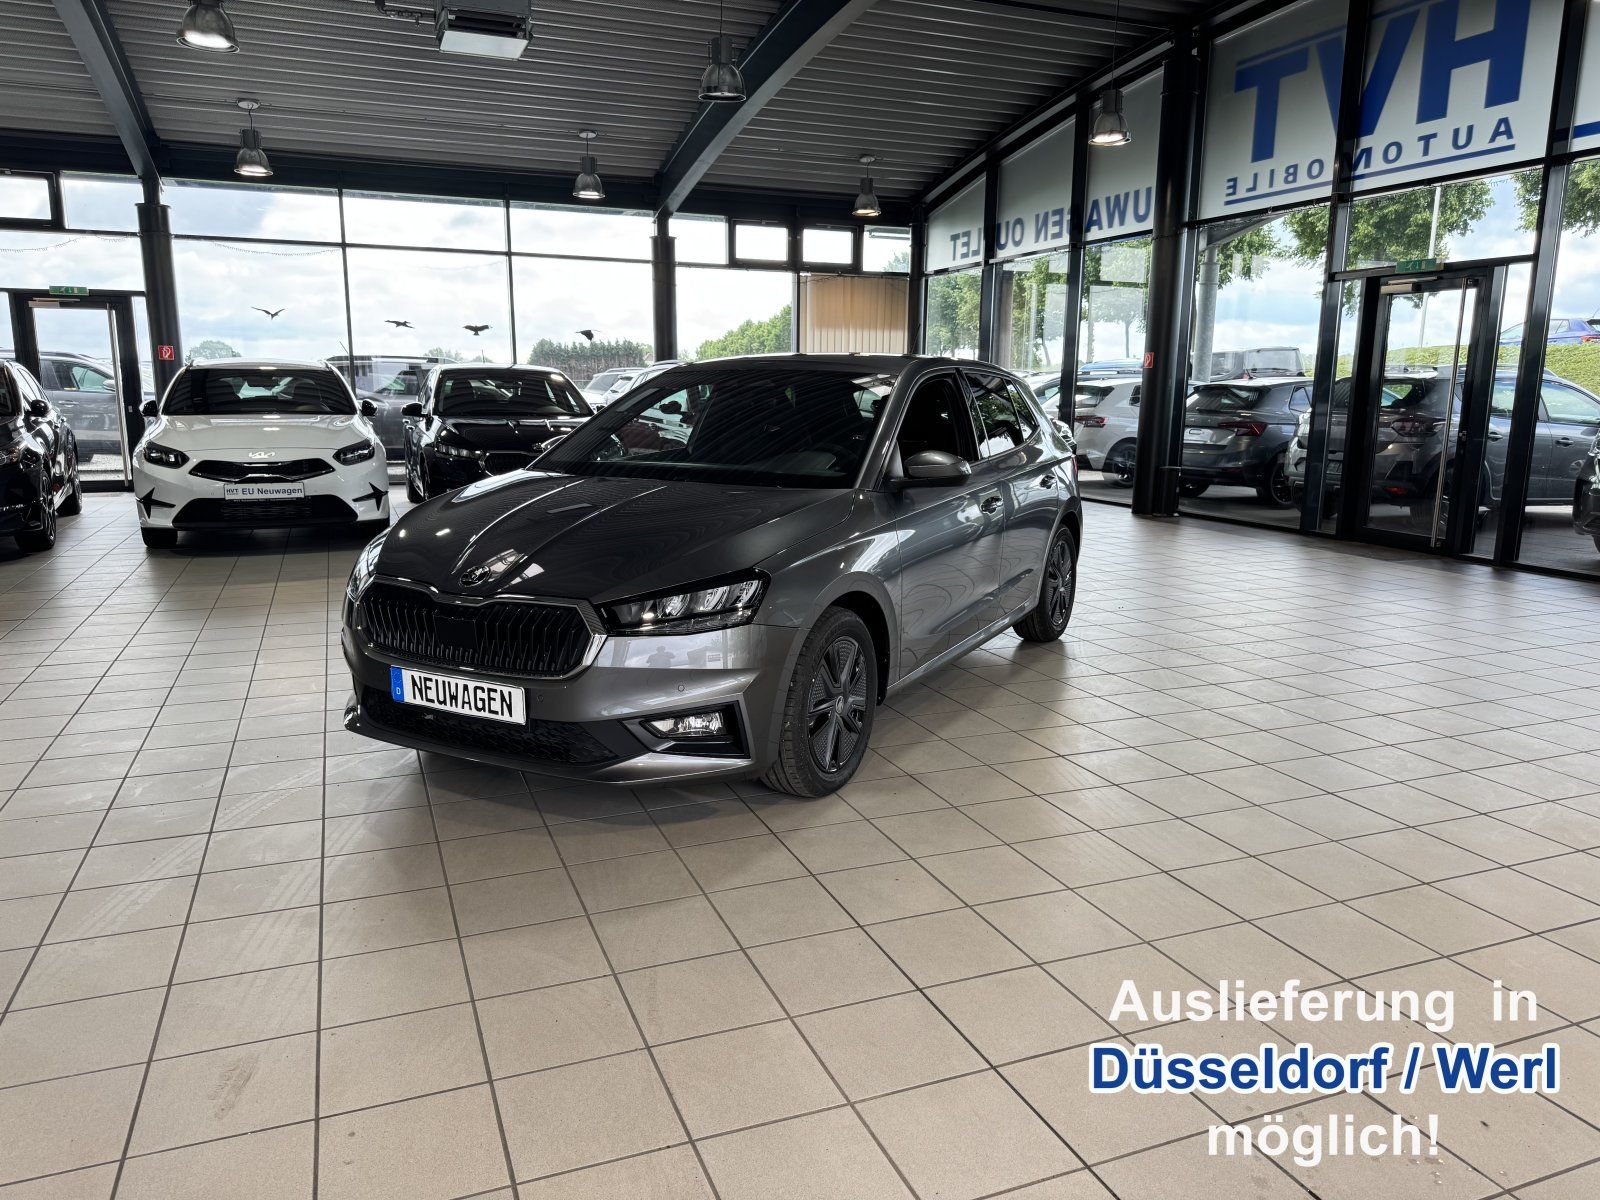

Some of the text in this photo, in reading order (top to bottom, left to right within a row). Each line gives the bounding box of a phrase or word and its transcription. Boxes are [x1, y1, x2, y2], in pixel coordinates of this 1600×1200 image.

[241, 487, 255, 496] EU
[257, 487, 303, 496] Neuwagen
[410, 674, 513, 718] NEUWAGEN
